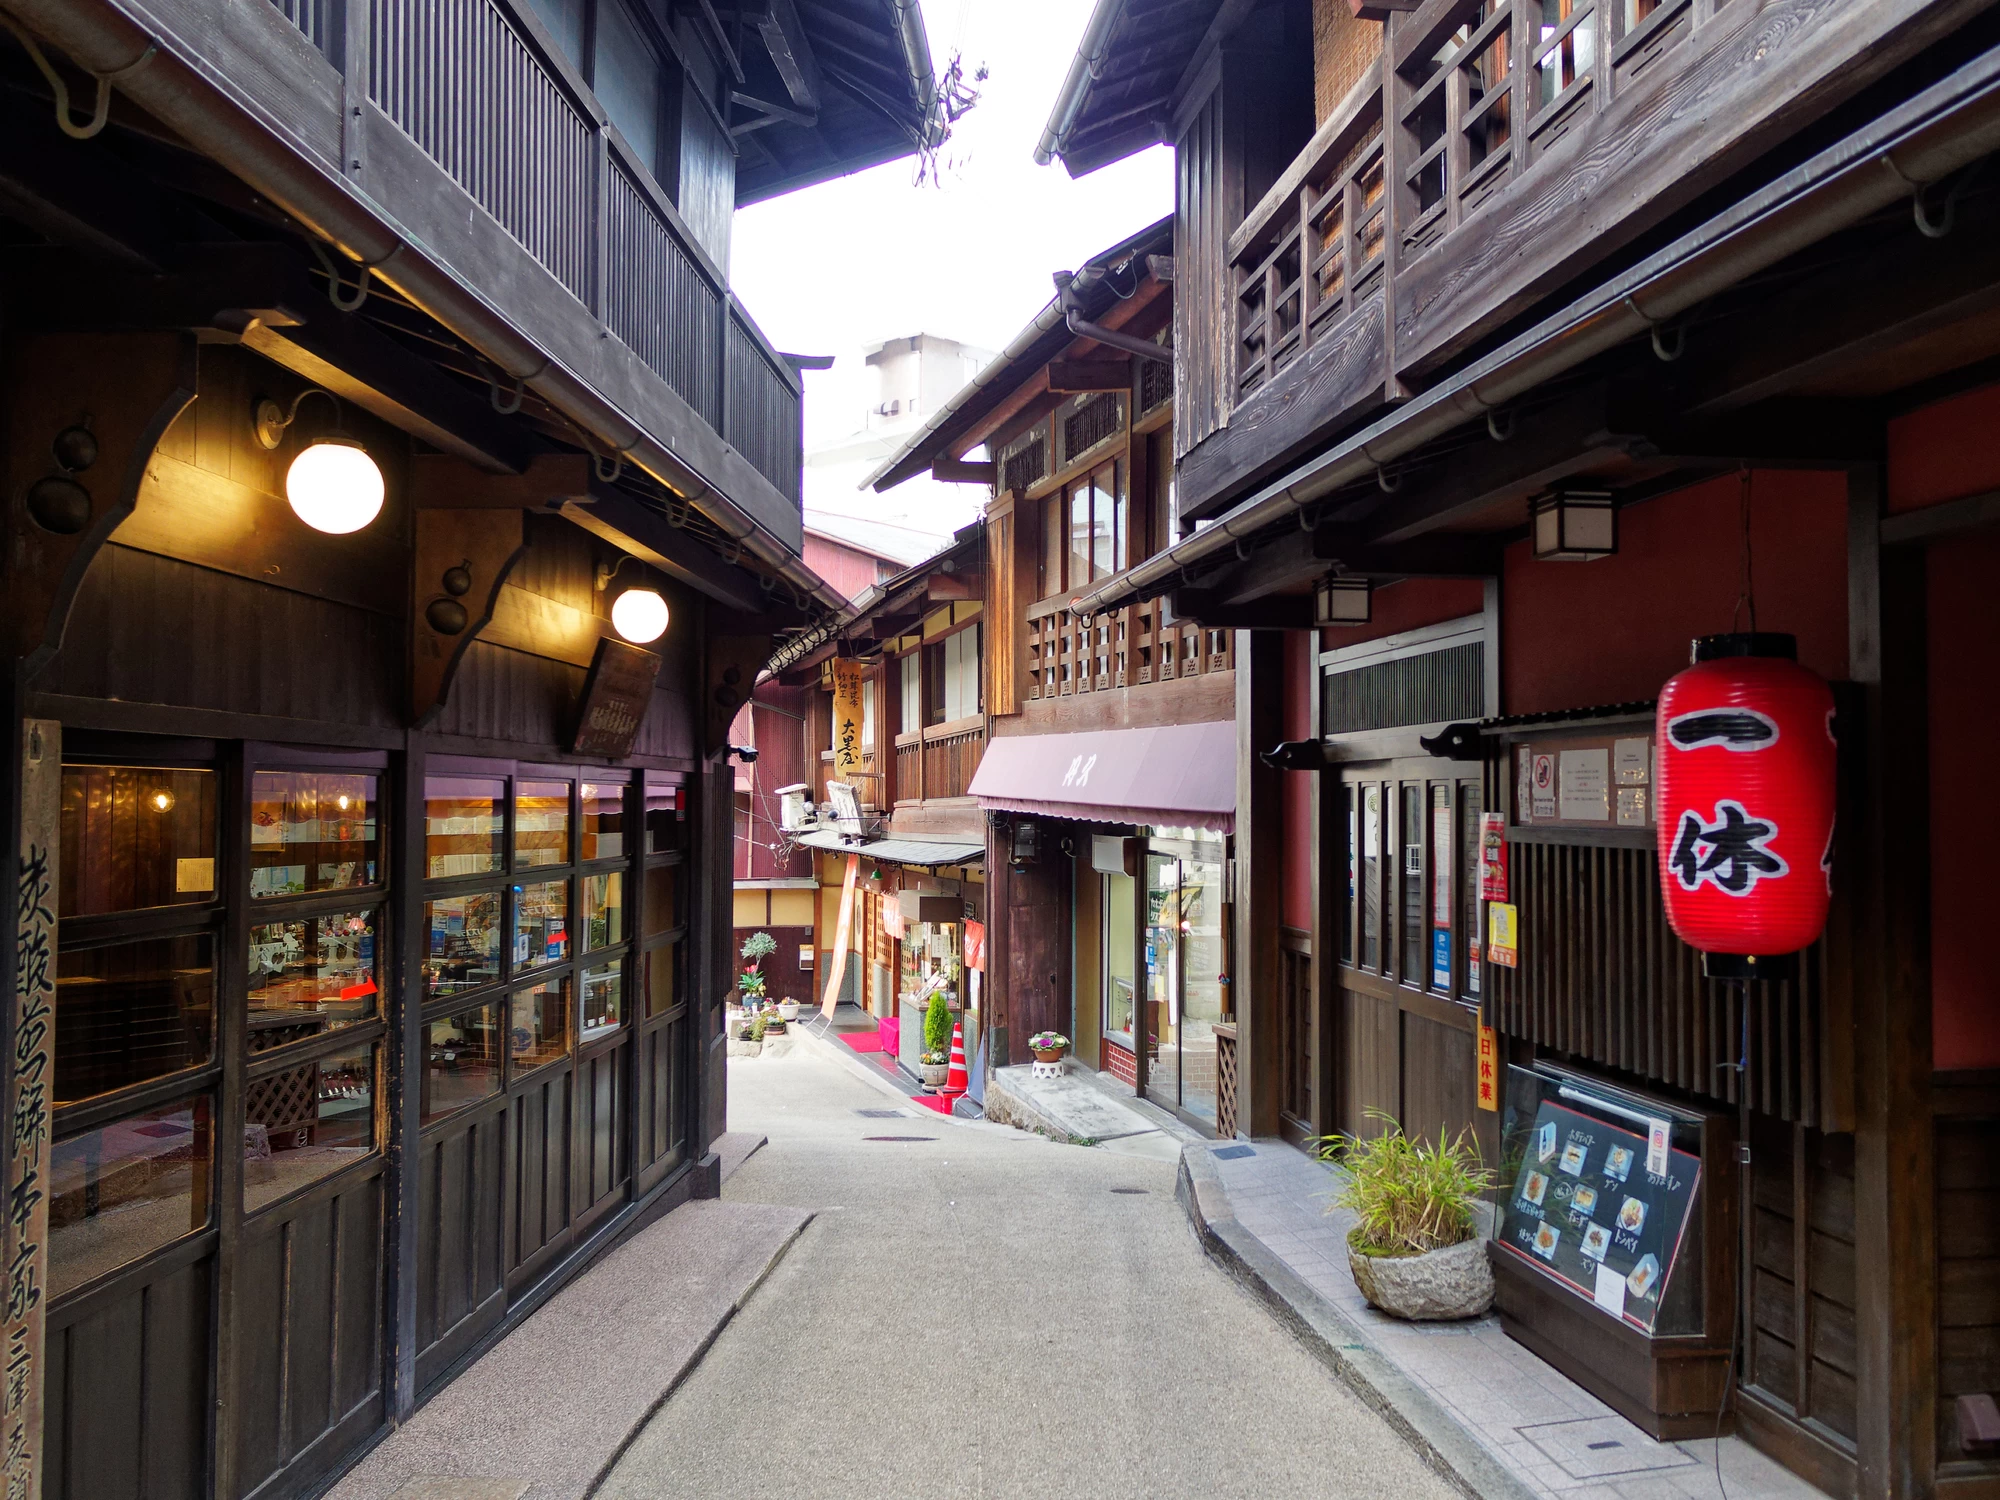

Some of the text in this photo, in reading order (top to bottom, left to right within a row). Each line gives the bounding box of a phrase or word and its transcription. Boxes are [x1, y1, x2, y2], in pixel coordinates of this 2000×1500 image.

[837, 718, 859, 767] 大黒屋
[1667, 706, 1789, 897] 一休
